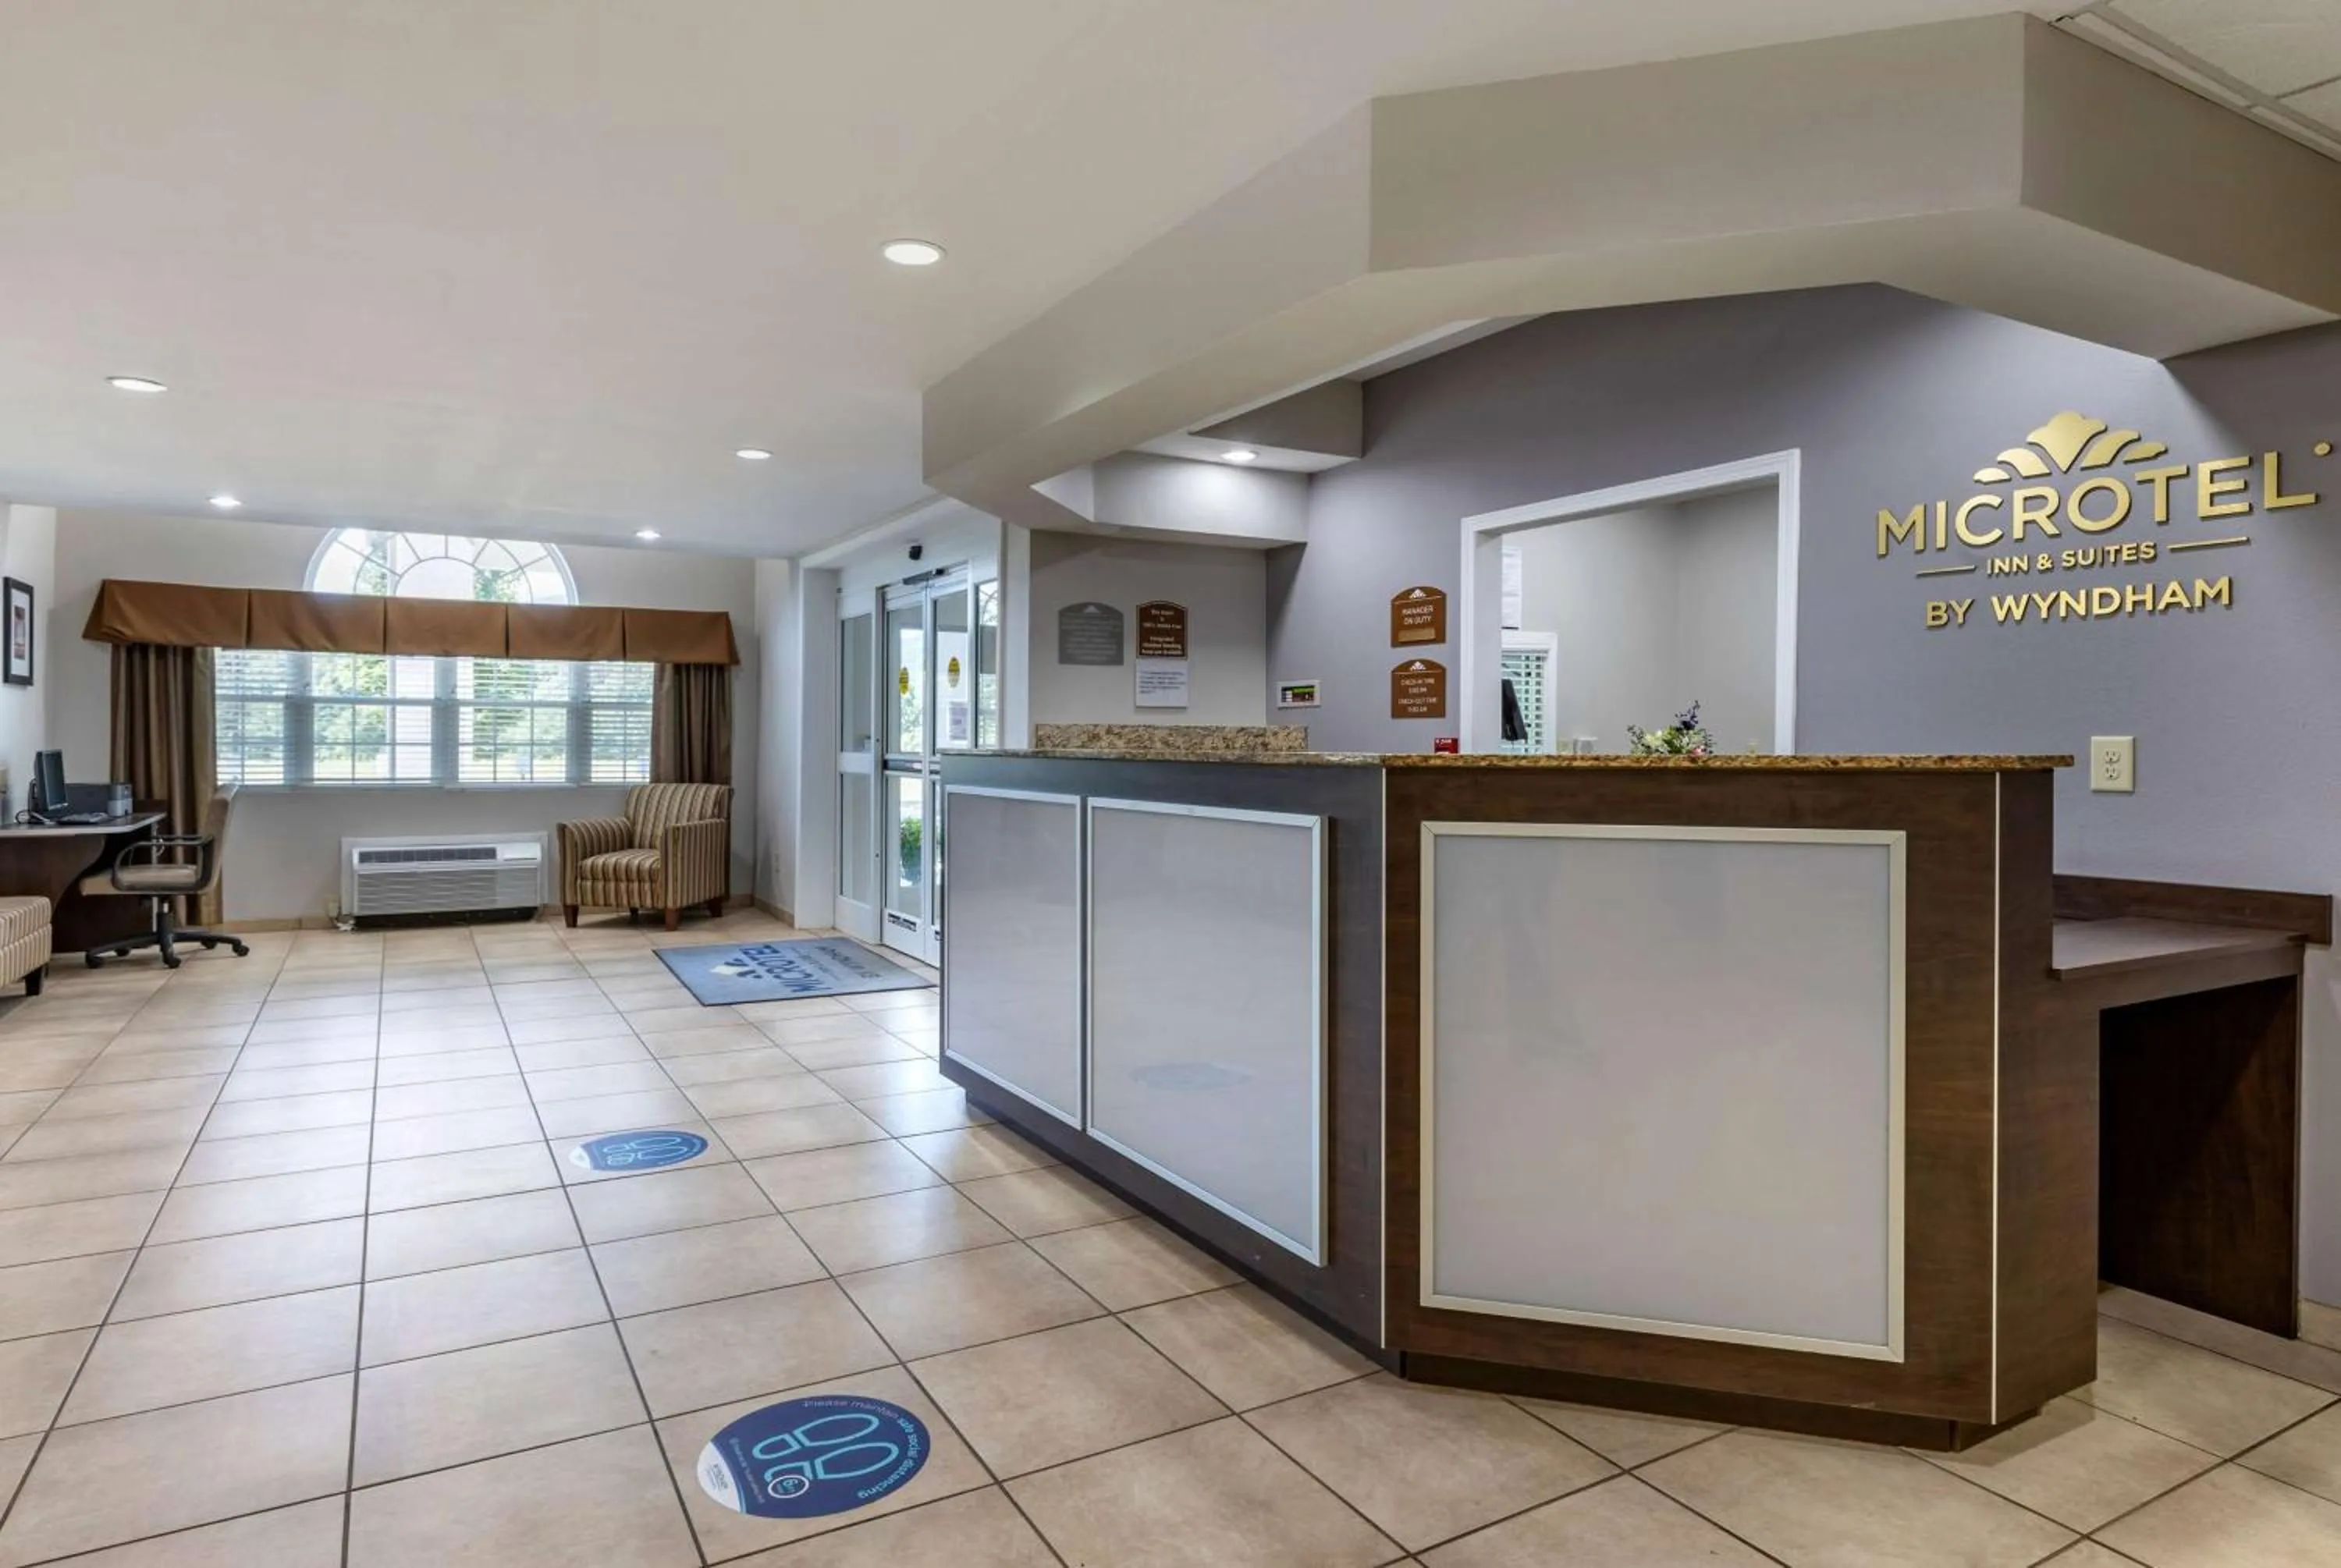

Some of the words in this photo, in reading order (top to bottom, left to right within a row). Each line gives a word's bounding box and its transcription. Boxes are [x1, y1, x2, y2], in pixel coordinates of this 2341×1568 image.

[1876, 450, 2318, 556] MICROTEL
[1986, 555, 2029, 576] INN
[2036, 552, 2053, 571] &
[2061, 541, 2158, 569] SUITES
[1926, 598, 1973, 628] BY
[1991, 576, 2233, 623] WYNDHAM
[907, 1434, 922, 1458] social
[857, 1456, 916, 1499] distancing
